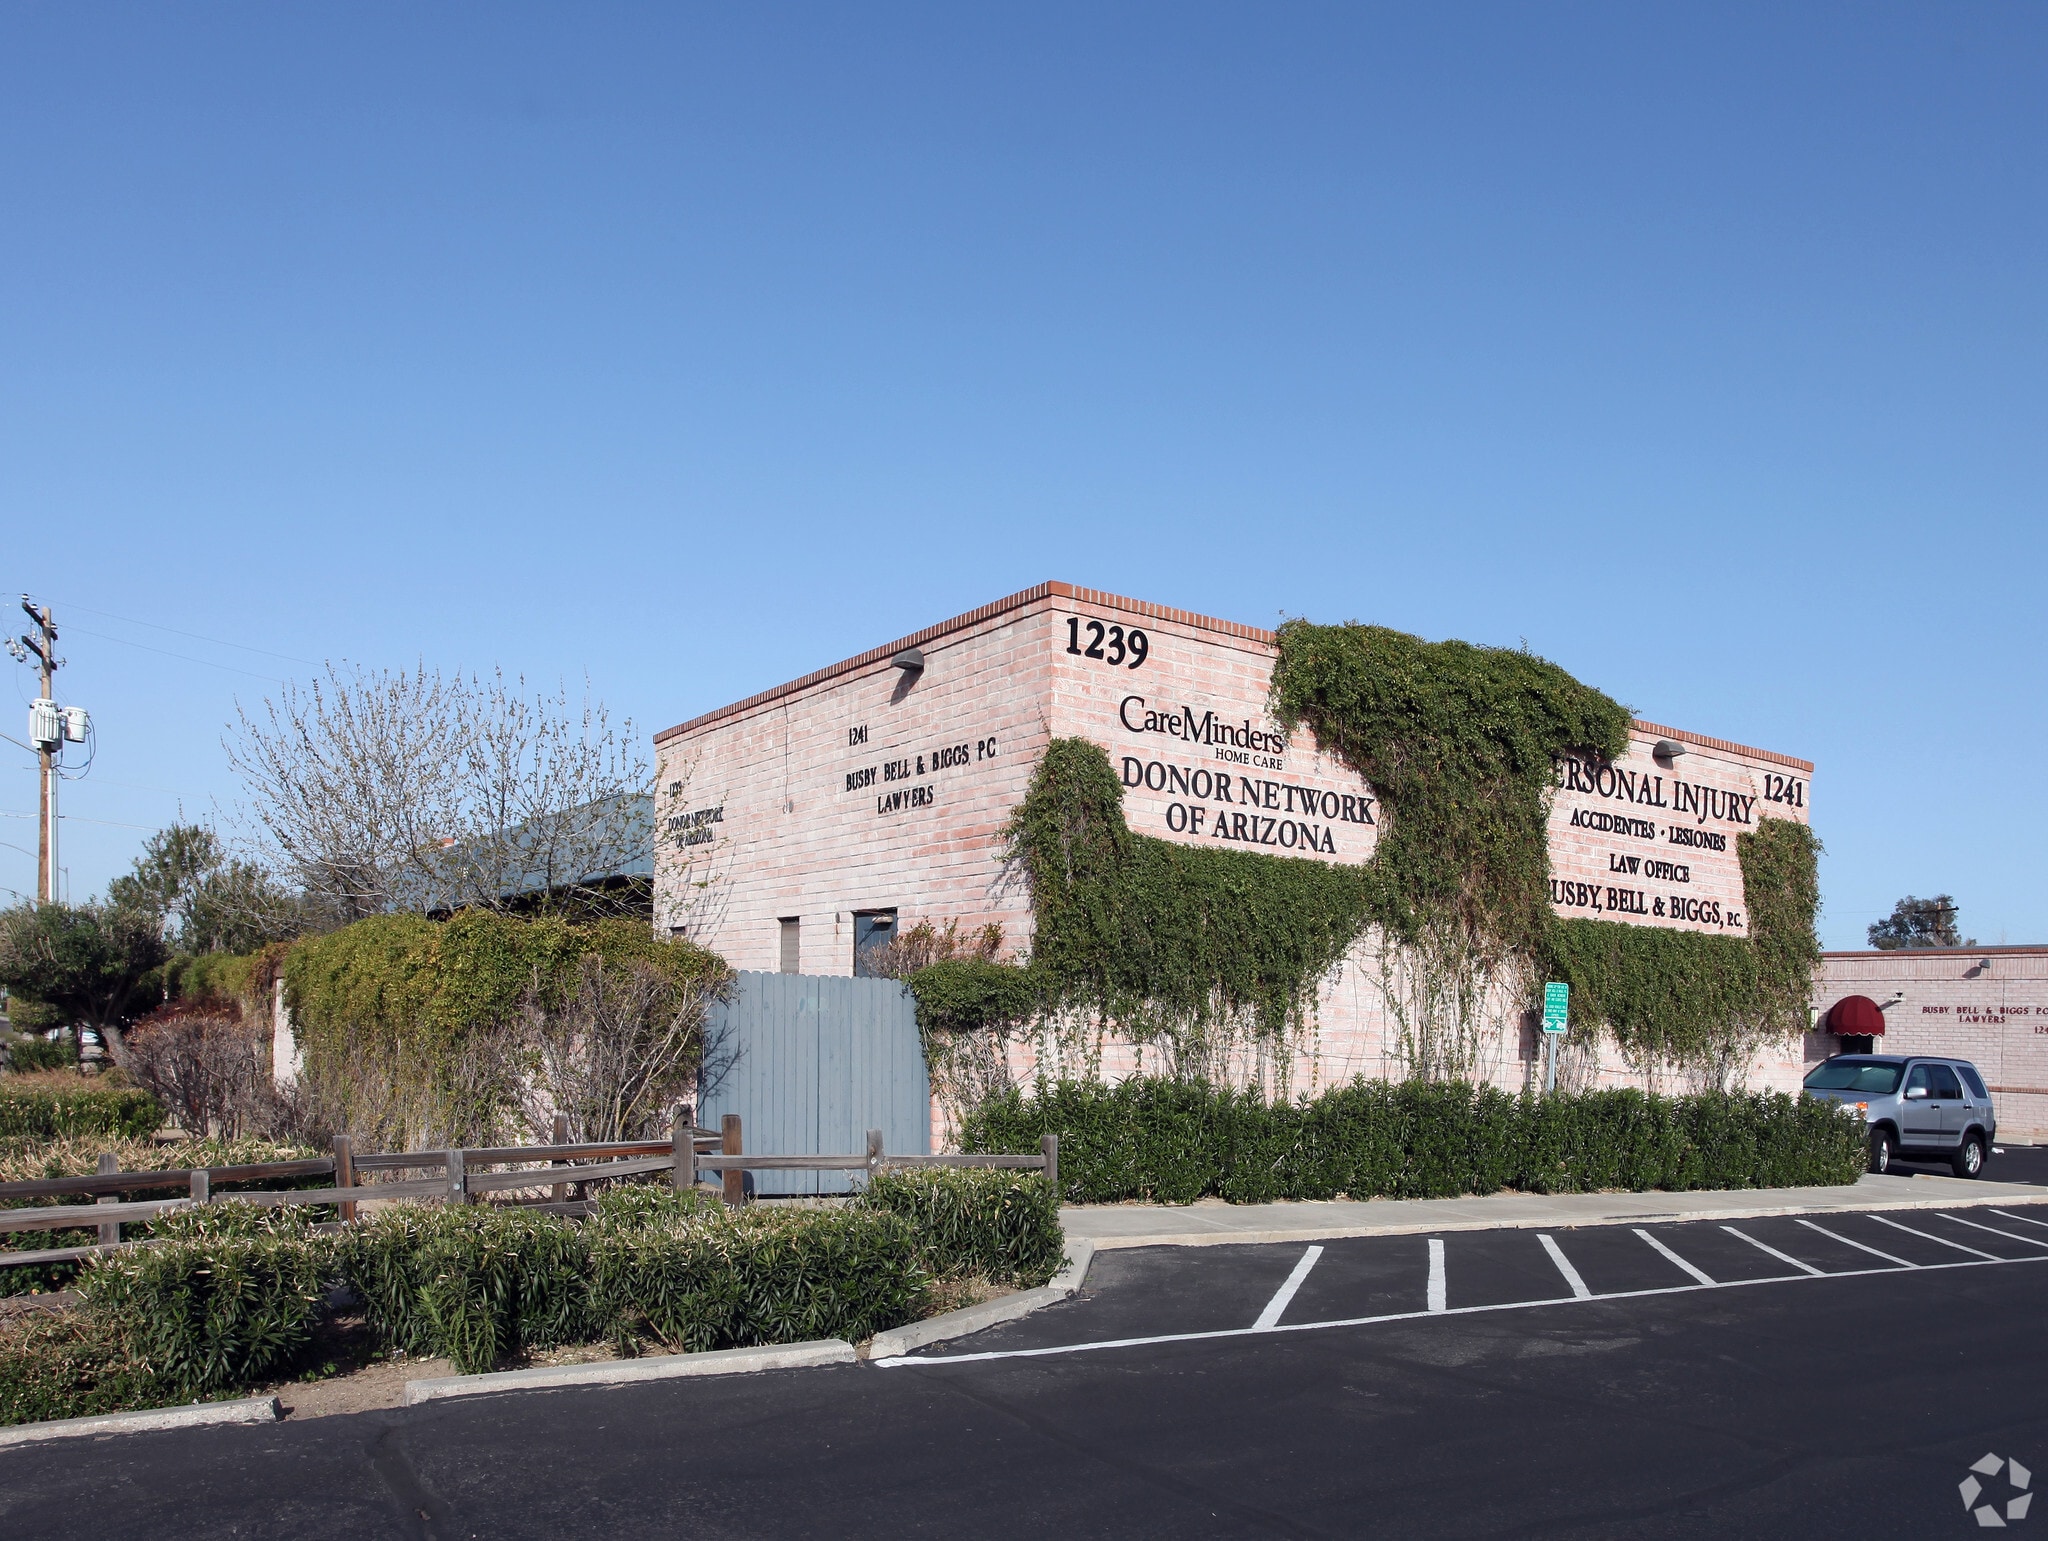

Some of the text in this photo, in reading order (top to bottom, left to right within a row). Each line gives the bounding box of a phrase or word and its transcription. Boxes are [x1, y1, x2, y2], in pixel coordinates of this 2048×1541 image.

[1066, 617, 1148, 669] 1239
[849, 725, 868, 746] 1241
[1119, 696, 1283, 754] CareMinders
[846, 766, 877, 792] BUSBY
[884, 759, 911, 782] BELL
[916, 755, 925, 775] &
[1215, 748, 1283, 771] HOME CARE
[878, 785, 934, 814] LAWYERS
[1121, 757, 1376, 825] DONOR NETWORK
[1551, 754, 1757, 824] ERSONAL INJURY
[1764, 774, 1803, 807] 1241
[1166, 803, 1336, 854] OF ARIZONA
[1570, 808, 1726, 851] ACCIDENTES LESIONES
[1609, 853, 1690, 883] LAW OFFICE
[1548, 879, 1602, 913] USBY,
[1606, 887, 1648, 915] BELL
[1653, 896, 1666, 917] &
[1669, 896, 1724, 929] BIGGS,
[1956, 1006, 1979, 1014] BELL
[1986, 1006, 1992, 1014] &
[1959, 1015, 2005, 1023] LAWYERS
